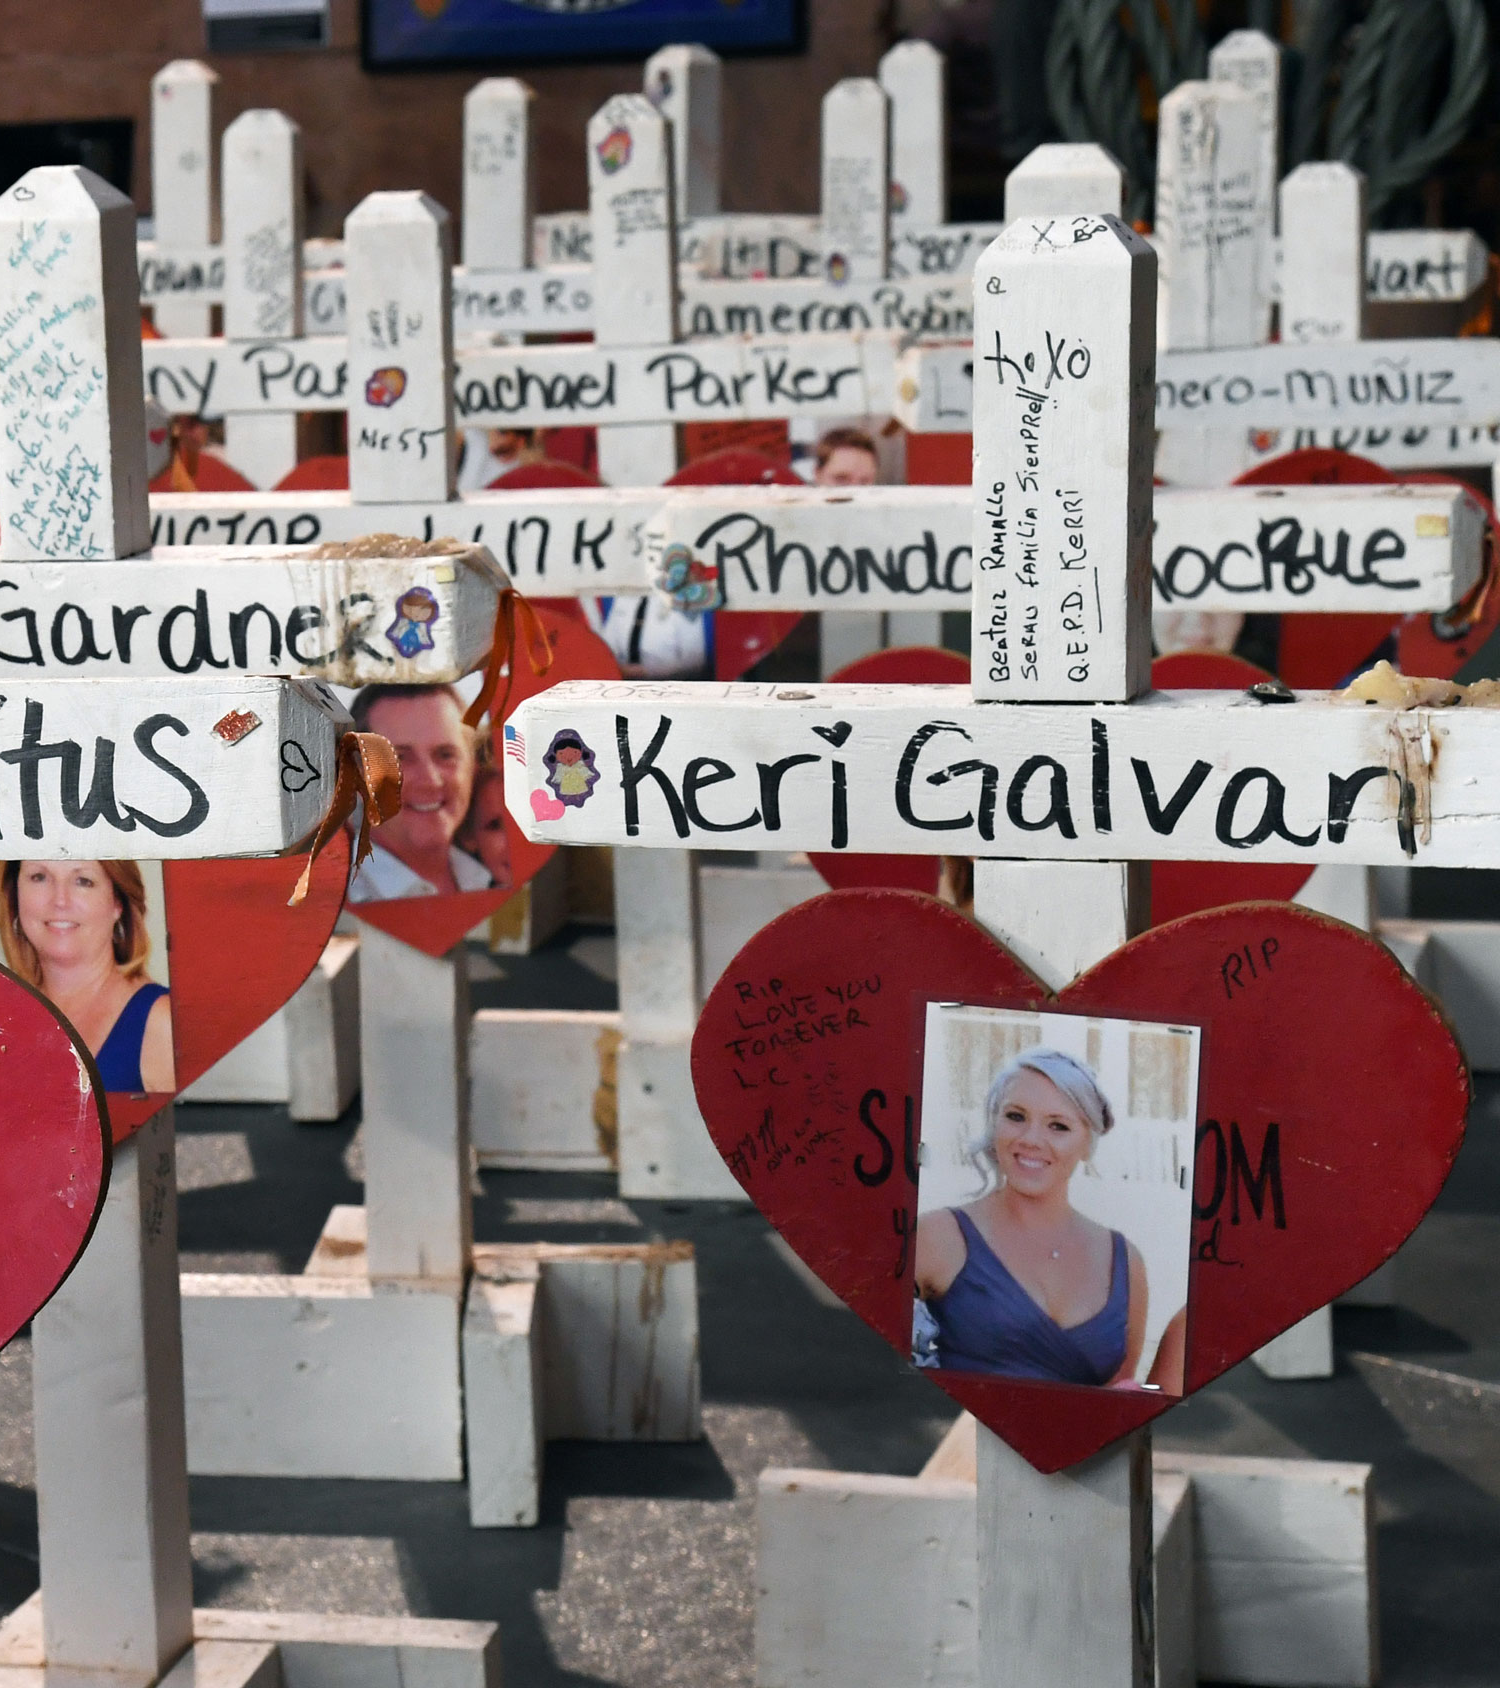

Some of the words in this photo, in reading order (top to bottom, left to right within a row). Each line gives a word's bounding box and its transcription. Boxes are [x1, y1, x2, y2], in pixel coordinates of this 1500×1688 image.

[680, 300, 872, 338] ameron
[616, 714, 846, 850] Keri
[735, 978, 783, 1003] RIP
[1219, 937, 1279, 1000] RIP
[734, 995, 819, 1032] LOVE
[825, 974, 882, 1003] YOU
[725, 1007, 870, 1062] FOREVER
